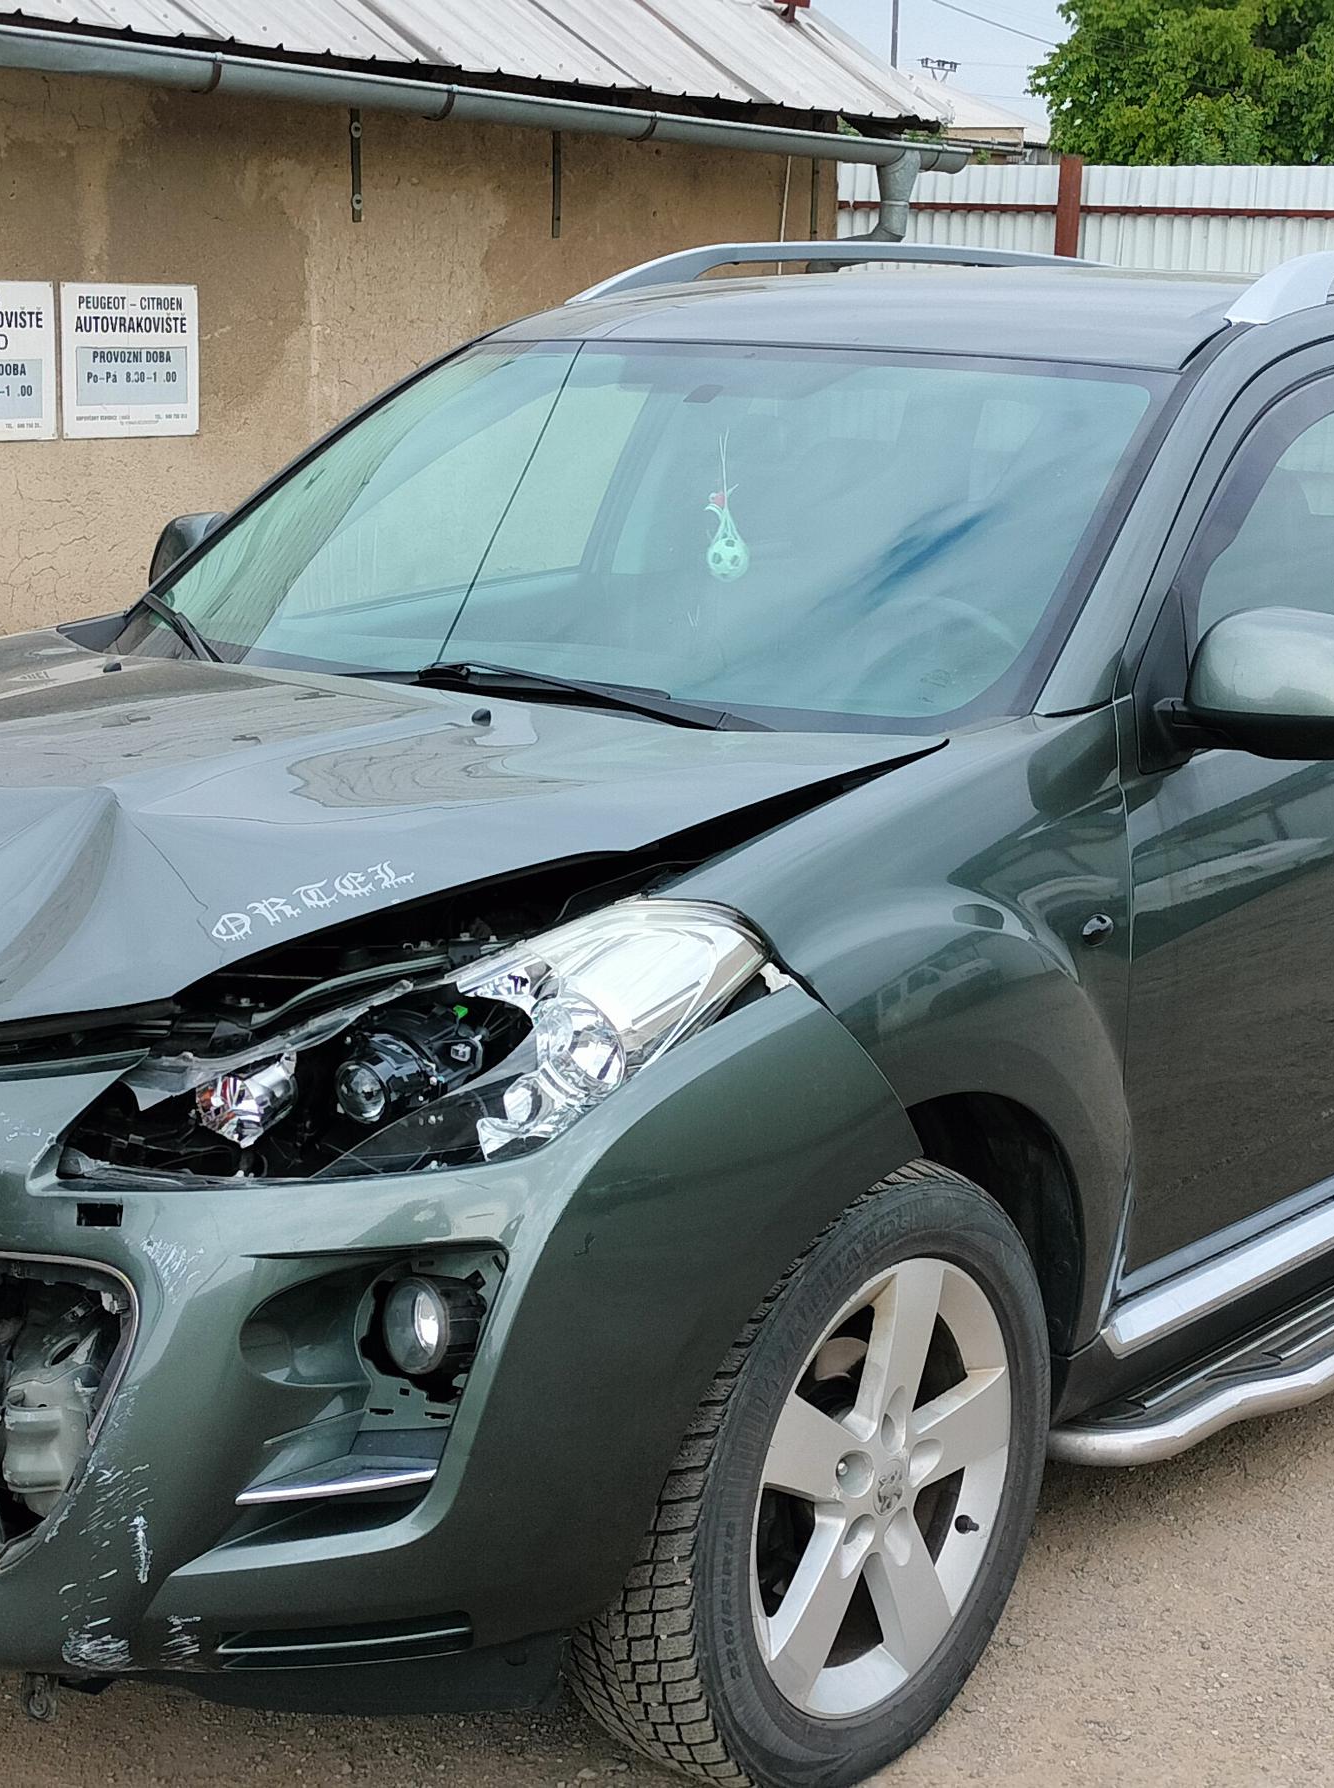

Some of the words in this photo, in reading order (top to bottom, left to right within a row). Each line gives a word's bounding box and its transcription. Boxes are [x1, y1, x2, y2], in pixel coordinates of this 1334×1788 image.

[78, 295, 126, 310] PEUGEOT
[74, 312, 187, 333] AUTOVRAKOVIŠTĚ
[92, 349, 143, 363] PROVOZNÍ
[145, 350, 172, 363] DOBA
[211, 860, 415, 942] ORTEL
